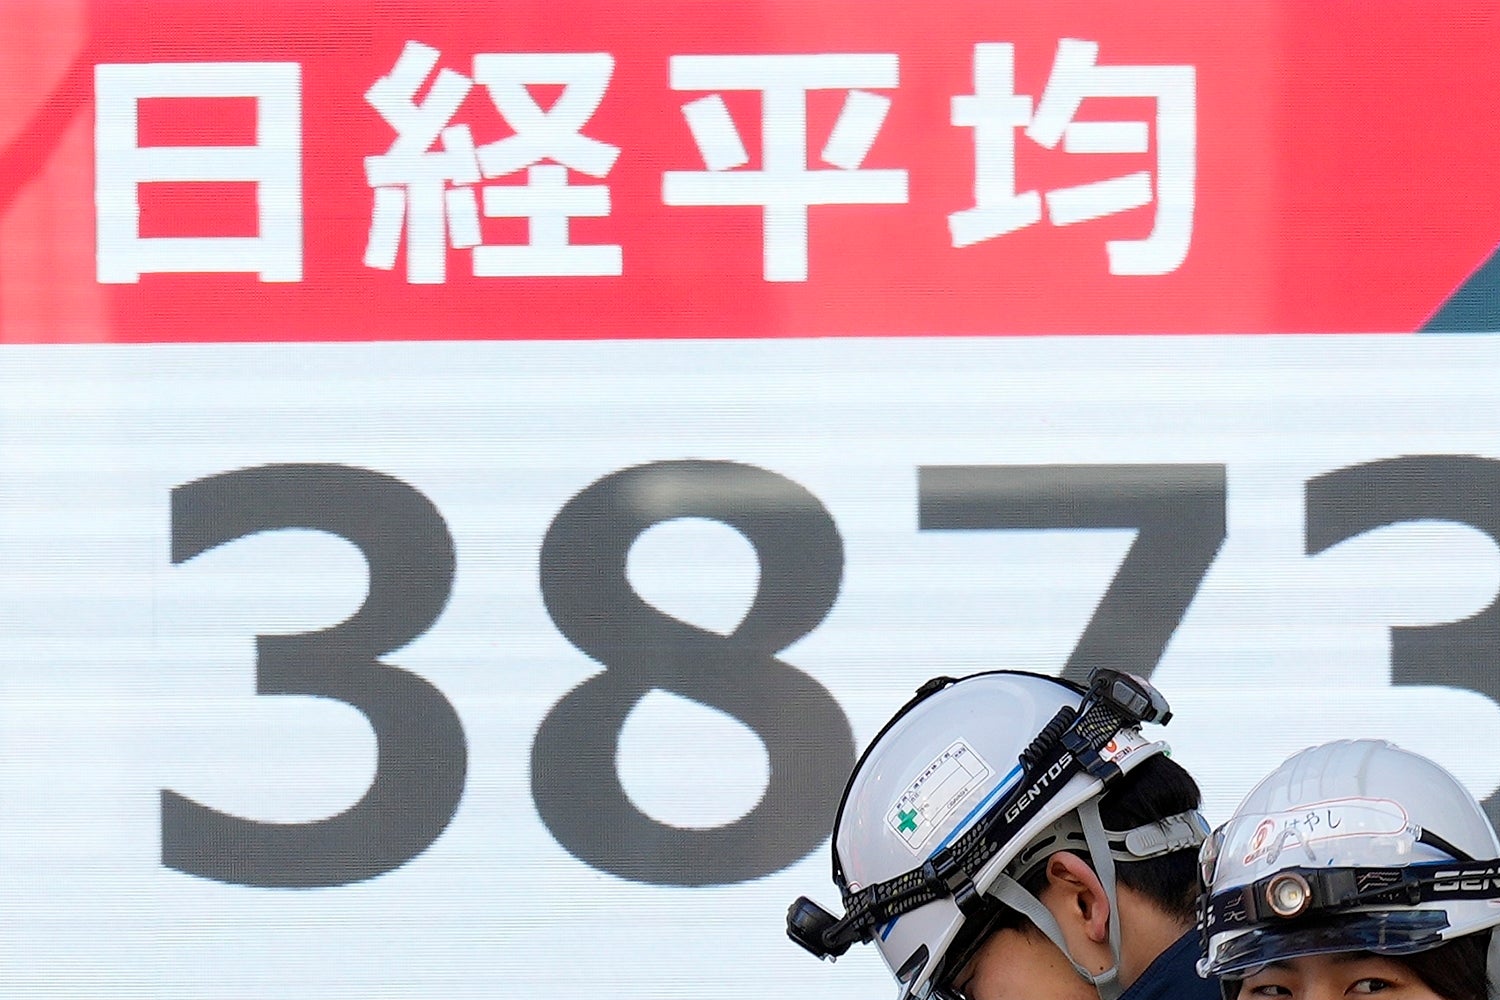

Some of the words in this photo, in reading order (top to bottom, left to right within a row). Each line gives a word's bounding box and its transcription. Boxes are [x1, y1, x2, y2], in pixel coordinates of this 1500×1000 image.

[93, 38, 1198, 285] 日経平均
[1004, 751, 1073, 824] GENTOS
